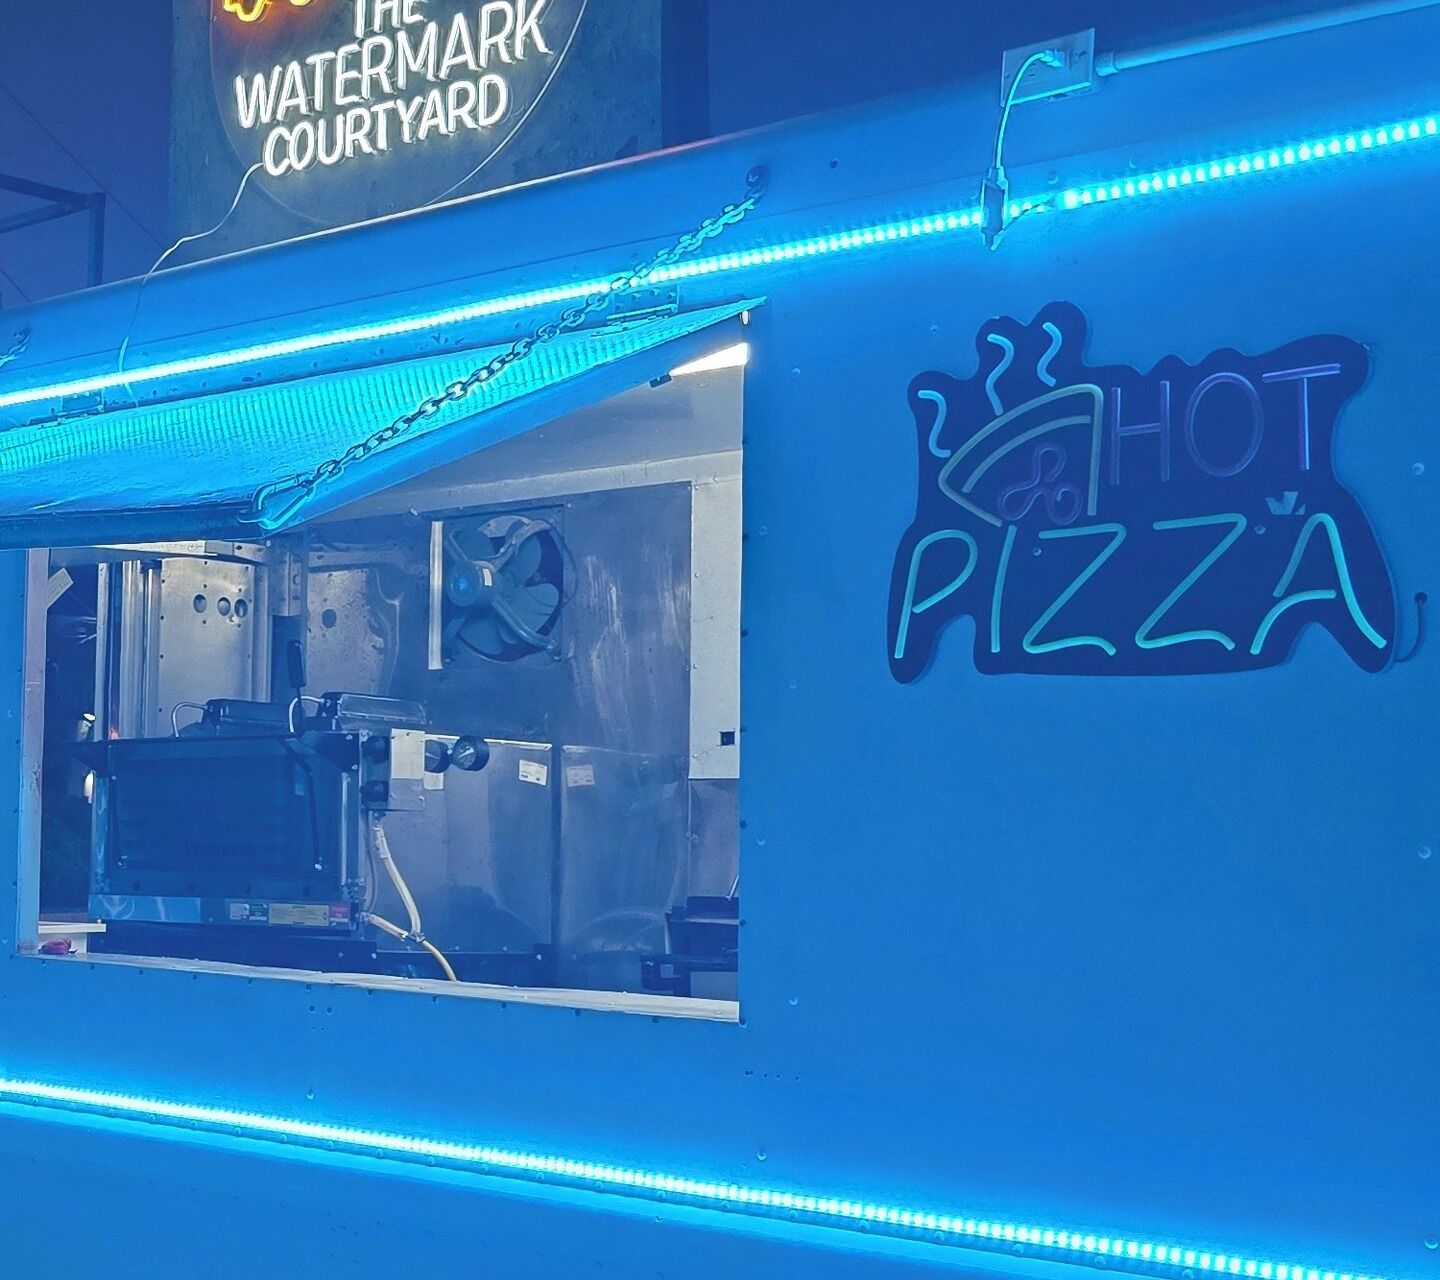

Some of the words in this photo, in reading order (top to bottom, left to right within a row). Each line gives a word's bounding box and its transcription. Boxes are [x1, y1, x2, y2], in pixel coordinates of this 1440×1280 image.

[263, 73, 509, 177] COURTYARD
[1110, 363, 1341, 486] HOT
[894, 512, 1388, 659] PIZZA
